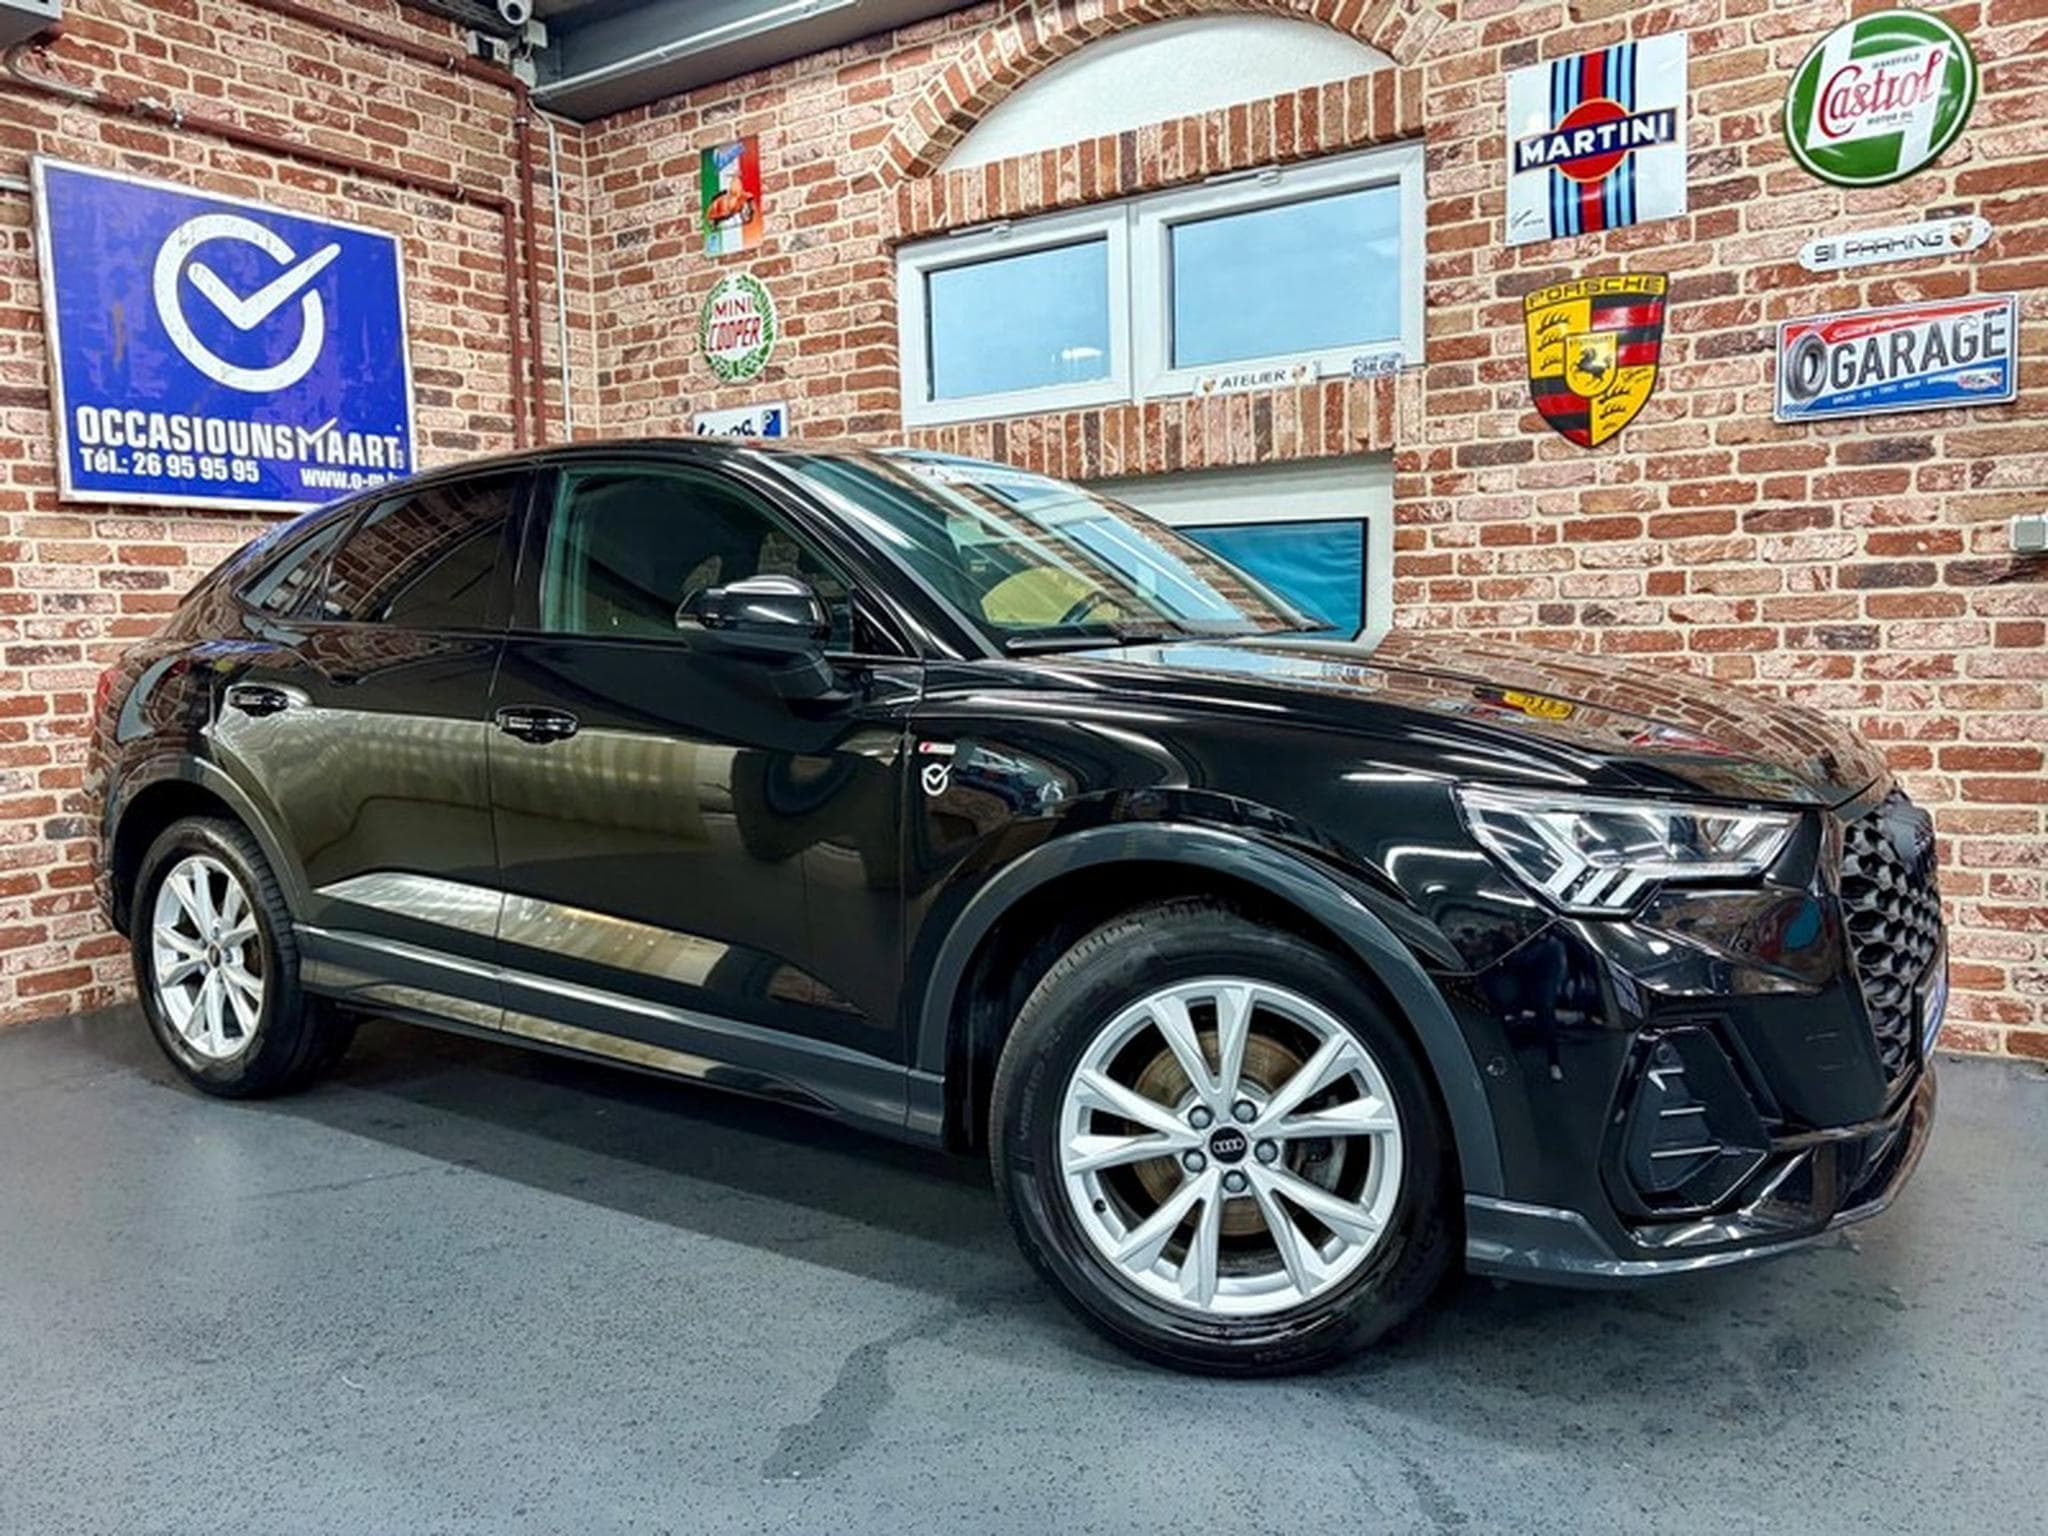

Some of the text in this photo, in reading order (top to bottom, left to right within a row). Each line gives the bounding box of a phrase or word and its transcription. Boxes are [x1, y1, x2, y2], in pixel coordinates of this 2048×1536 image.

[1818, 49, 1944, 140] Castrol
[1866, 112, 1898, 126] MOTOR
[1519, 112, 1669, 168] MARTINI
[1843, 228, 1944, 260] PARKING
[714, 297, 751, 317] MINI
[1527, 276, 1663, 308] PORSCHE
[709, 316, 761, 352] COOPER
[1830, 314, 2008, 390] GARAGE
[1220, 369, 1287, 389] ATELIER
[76, 406, 399, 469] OCCASIOUNSMAART
[79, 447, 260, 483] Tél.: 26 95 95 95
